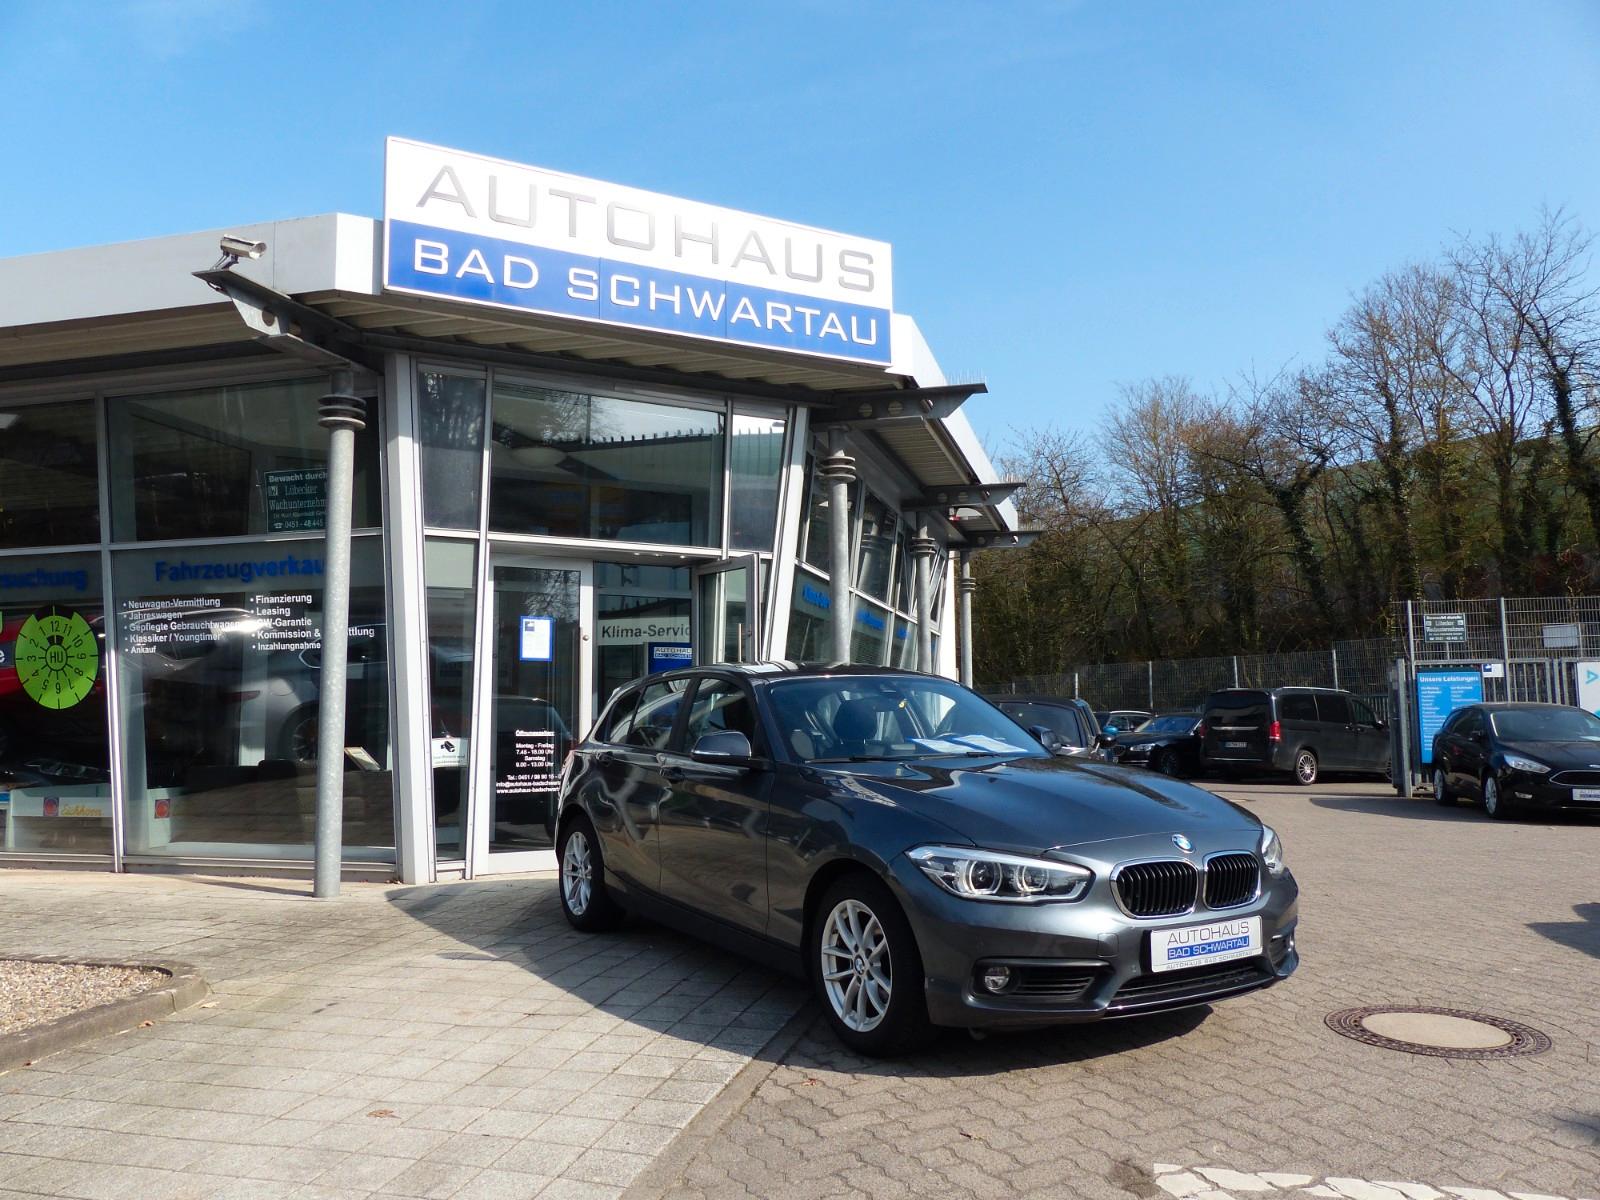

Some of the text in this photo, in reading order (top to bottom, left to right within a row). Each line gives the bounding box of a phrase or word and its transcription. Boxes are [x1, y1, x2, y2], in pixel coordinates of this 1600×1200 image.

[416, 164, 875, 293] AUTOHAUS
[413, 238, 878, 346] BAD SCHWARTAU
[128, 598, 221, 609] Neuwagen-Vermittlung
[255, 594, 312, 604] Finanzierung
[129, 612, 182, 621] Jahreswagen
[256, 606, 291, 616] Leasing
[39, 626, 46, 636] 1
[50, 620, 60, 632] 12
[63, 623, 73, 635] 11
[129, 620, 240, 632] Gepflegte Gebrauchtwagen
[130, 634, 168, 643] Klassiker
[174, 632, 222, 643] Youngtimer
[257, 629, 312, 639] Kommission
[314, 629, 321, 638] &
[29, 638, 39, 649] 2
[72, 635, 84, 648] 10
[258, 641, 321, 651] Inzahlungnahme
[131, 645, 156, 654] Ankauf
[50, 651, 64, 664] HU
[31, 668, 40, 677] 4
[74, 667, 84, 676] 8
[42, 679, 50, 690] 5
[67, 678, 75, 690] 7
[1167, 921, 1250, 946] AUTOHAUS
[1168, 937, 1250, 959] BAD SCHWARTAU
[1166, 960, 1202, 970] AUTOHAUS
